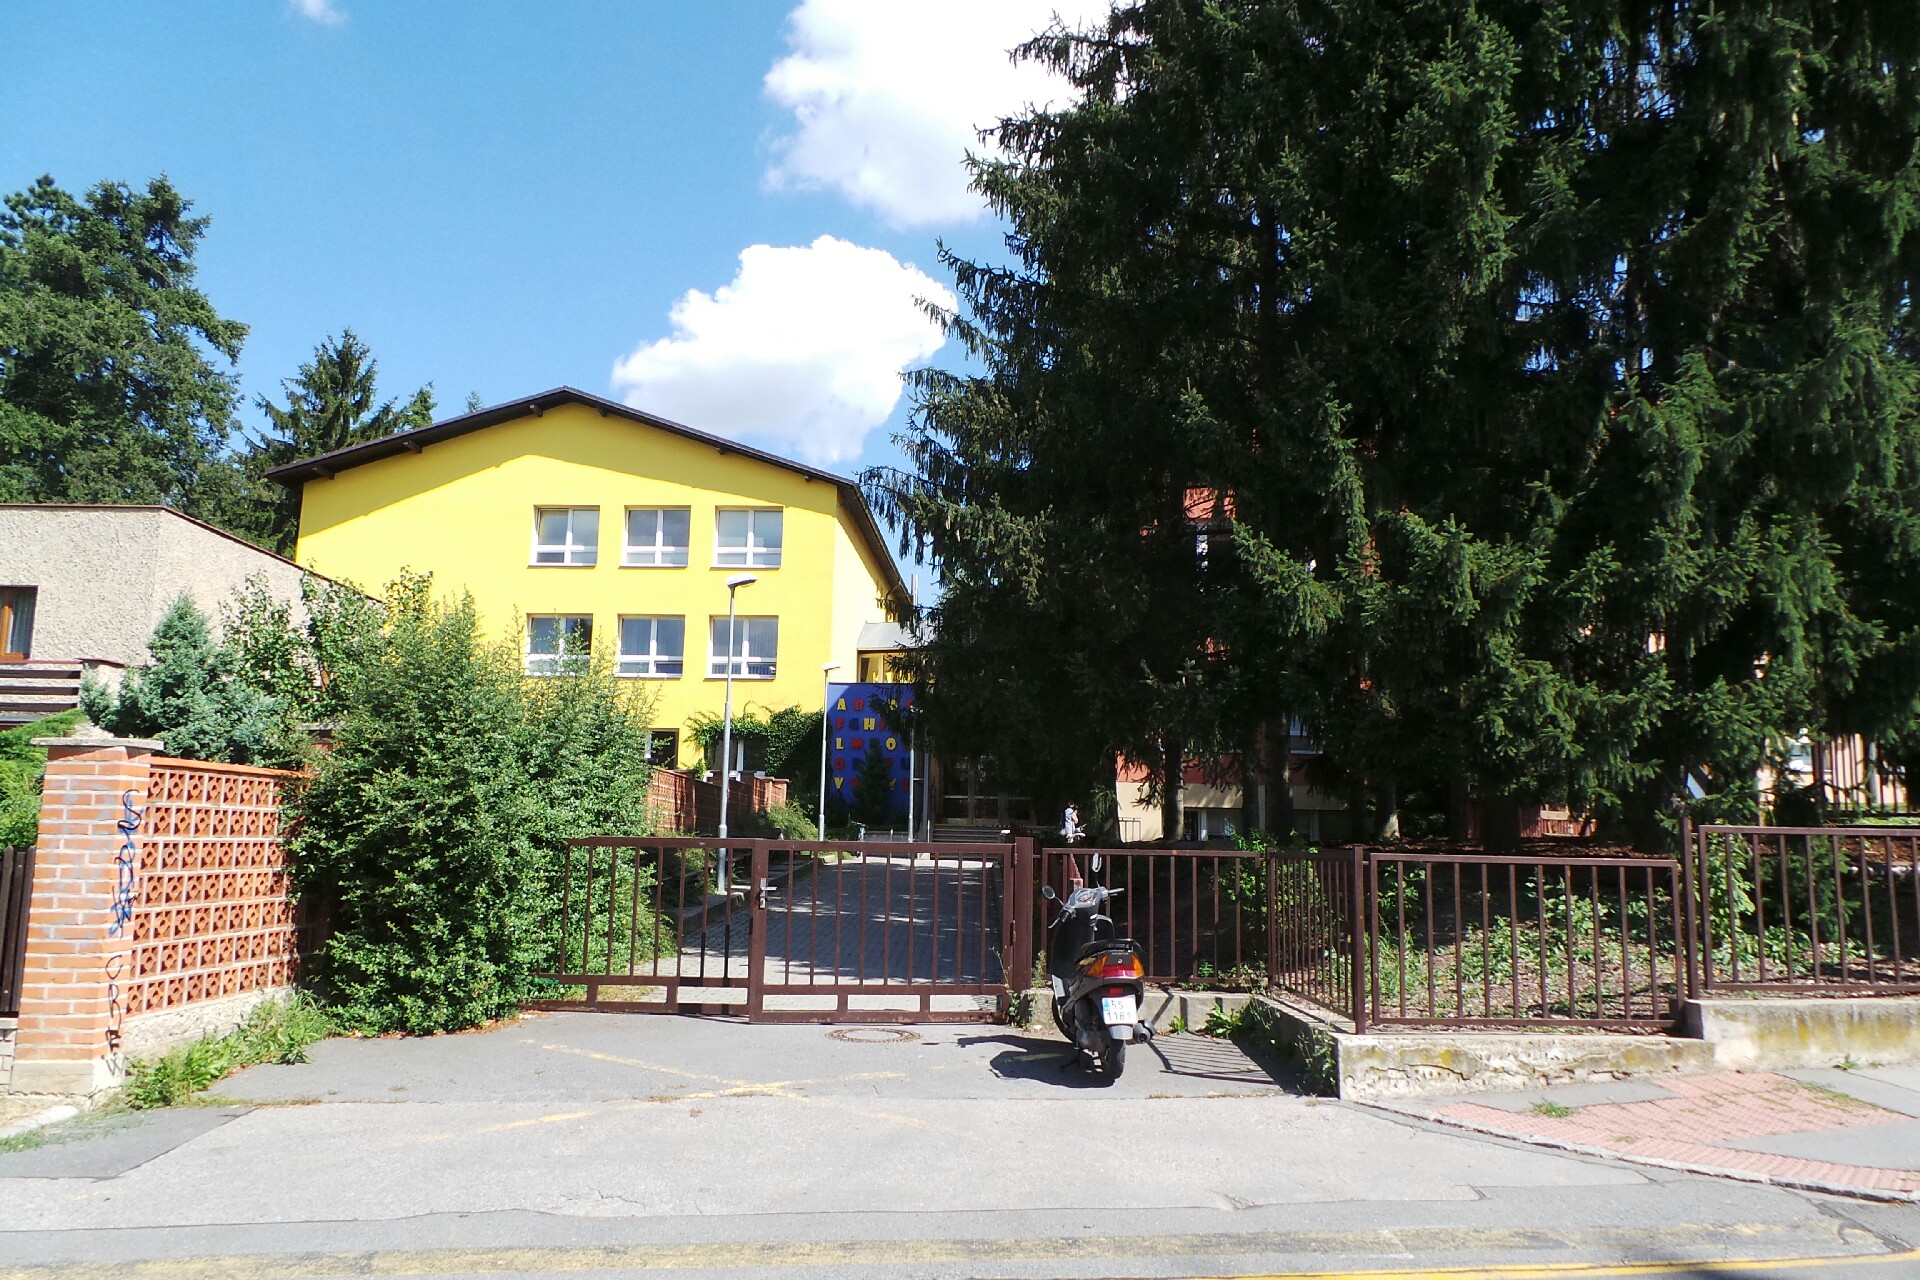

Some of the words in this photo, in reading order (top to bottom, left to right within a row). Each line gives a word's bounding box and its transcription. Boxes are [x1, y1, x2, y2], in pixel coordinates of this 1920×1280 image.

[836, 698, 846, 711] A
[854, 698, 864, 711] B
[863, 718, 875, 731] H
[836, 738, 844, 750] L
[851, 738, 863, 750] M
[885, 738, 897, 751] O
[834, 777, 844, 789] V
[1110, 999, 1124, 1010] 5S
